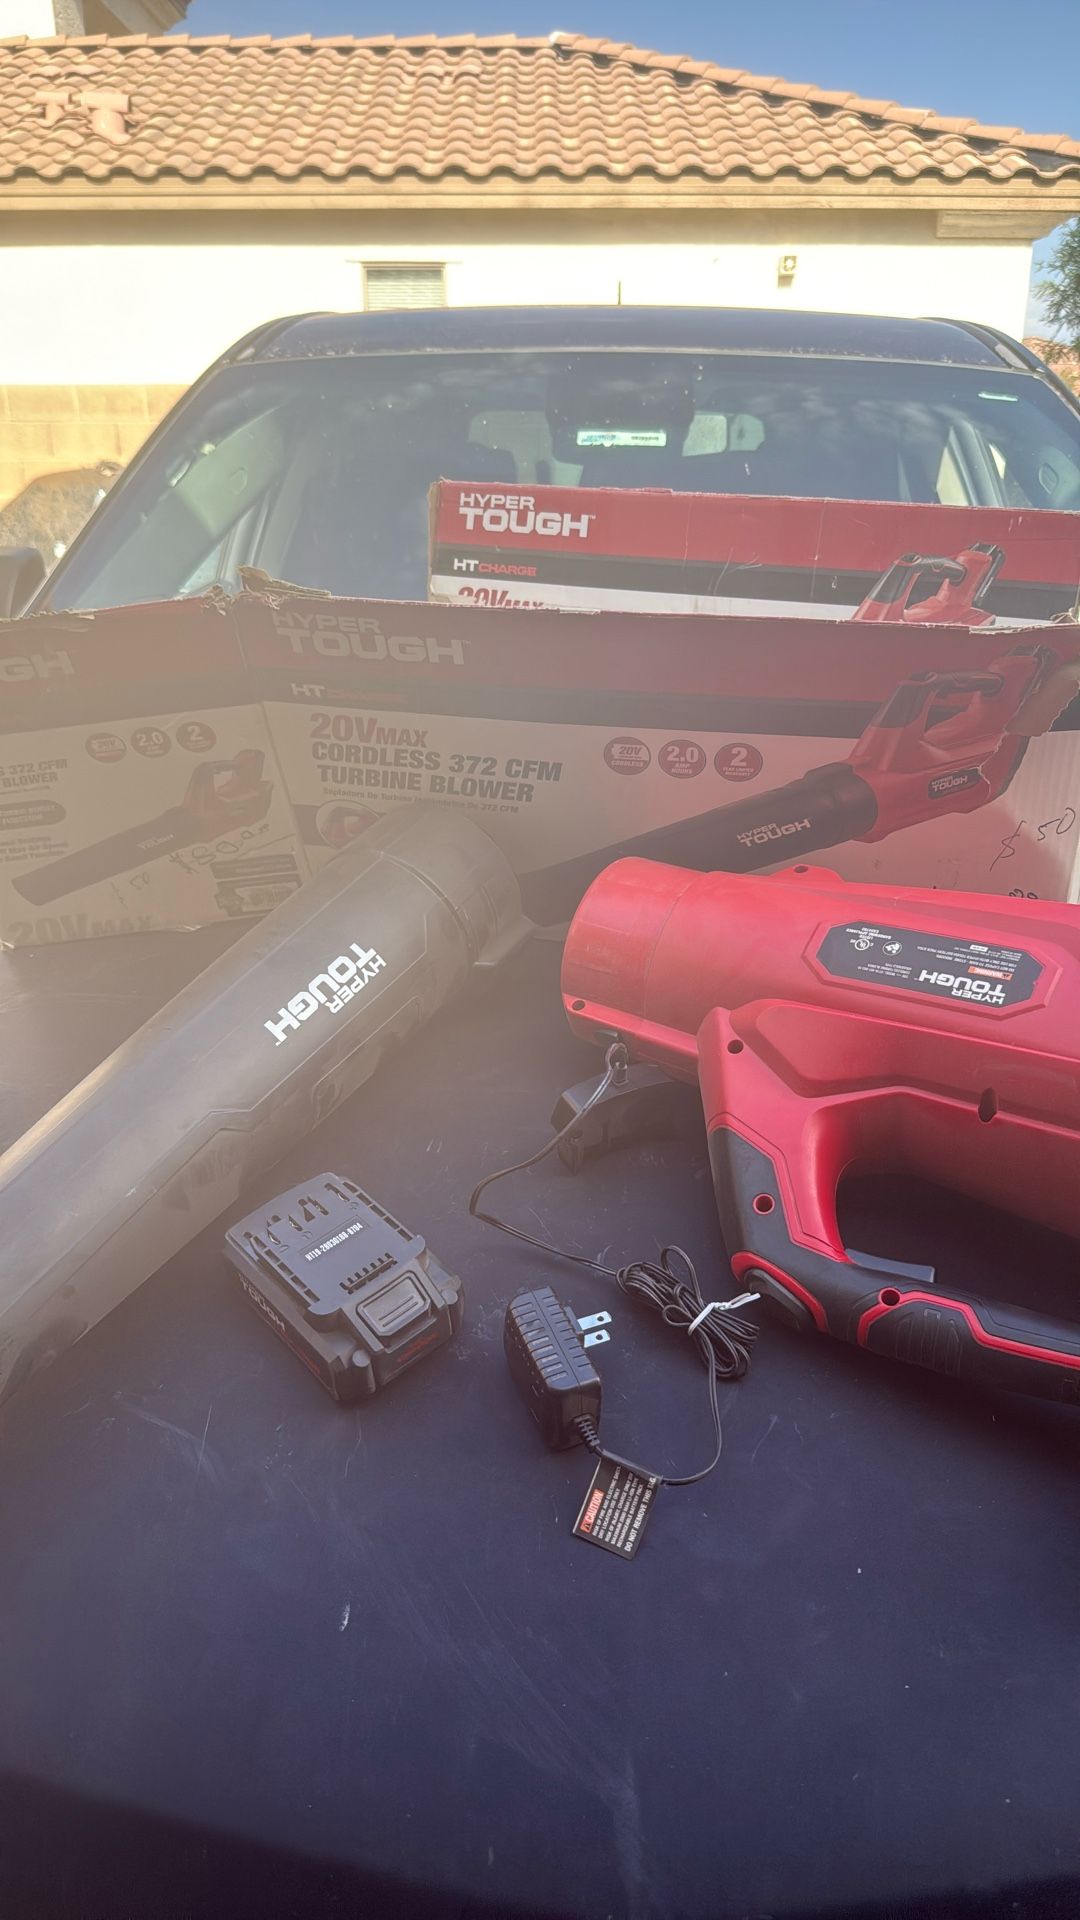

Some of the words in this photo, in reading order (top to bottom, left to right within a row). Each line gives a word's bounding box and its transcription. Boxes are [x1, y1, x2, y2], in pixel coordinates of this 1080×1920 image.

[460, 492, 535, 511] HYPER
[460, 506, 590, 538] TOUGH
[272, 611, 382, 634] HYPER
[275, 628, 465, 665] TOUGH
[136, 732, 164, 747] 2.0
[186, 724, 204, 740] 2
[311, 742, 441, 771] CORDLESS
[448, 754, 496, 777] 372
[504, 758, 563, 782] CFM
[666, 746, 699, 763] 2.0
[730, 746, 748, 767] 2
[9, 763, 36, 775] 372
[39, 759, 68, 772] CFM
[2, 772, 58, 788] BLOWER
[317, 764, 422, 793] TURBINE
[430, 774, 535, 803] BLOWER
[932, 776, 968, 792] TOUGH
[736, 823, 778, 842] HYPER
[740, 818, 812, 848] TOUGH
[264, 942, 377, 1042] TOUGH
[324, 954, 387, 1014] HYPER
[918, 970, 1006, 998] TOUGH
[951, 988, 1004, 1005] HYPER
[586, 1490, 604, 1524] CAUTION
[624, 1542, 632, 1551] DO
[628, 1529, 636, 1541] NOT
[633, 1504, 646, 1529] REMOVE
[643, 1489, 652, 1503] THIS
